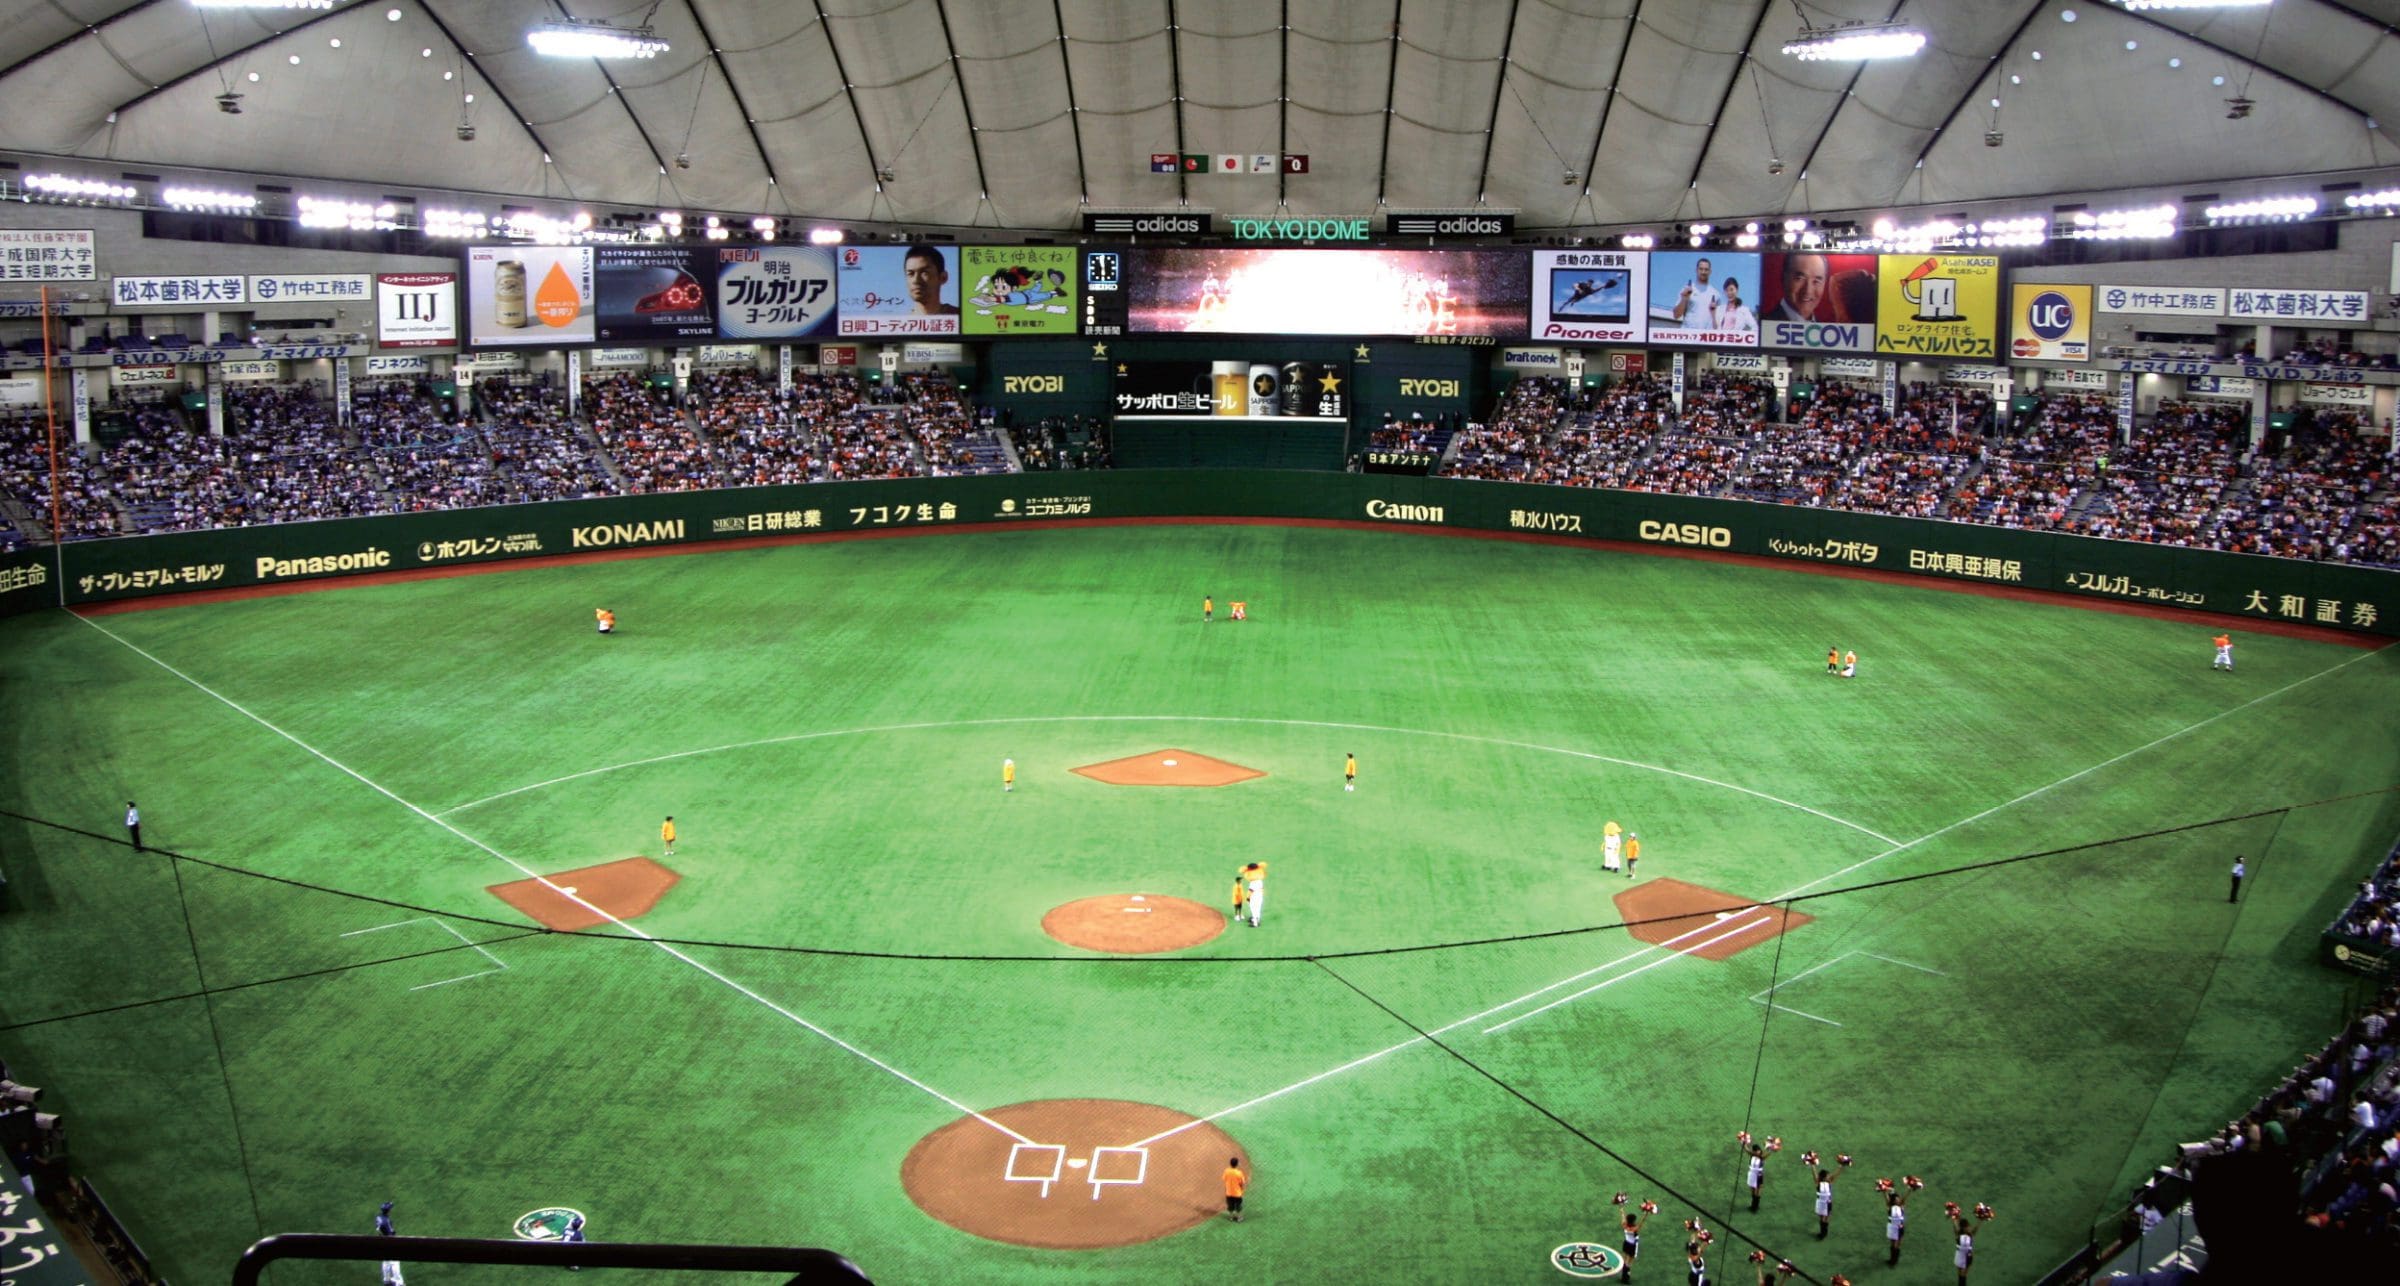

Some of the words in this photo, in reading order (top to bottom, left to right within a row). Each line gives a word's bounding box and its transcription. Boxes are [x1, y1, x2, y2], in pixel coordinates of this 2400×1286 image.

[1136, 217, 1199, 233] adidas
[1230, 220, 1304, 240] TOKYO
[1308, 220, 1370, 240] DOME
[1438, 218, 1502, 234] adidas
[720, 248, 760, 263] MEIJI
[1556, 254, 1627, 266] 感動の高画質
[764, 261, 791, 274] 明治
[118, 279, 241, 301] 松本歯科大学
[282, 280, 363, 296] 竹中工務店
[726, 275, 829, 306] ブルガリア
[395, 292, 439, 322] IIJ
[2131, 293, 2217, 310] 竹中工務店
[2233, 292, 2364, 317] 松本歯科大学
[746, 305, 810, 323] ヨーグルト
[842, 319, 956, 333] 日興コーディアル証券
[1544, 323, 1634, 341] Pioneer
[1776, 323, 1857, 348] SECOM
[1878, 335, 1993, 355] ヘーベルハウス
[113, 352, 171, 365] B.V.D.
[1779, 372, 1784, 381] 3
[2244, 365, 2305, 380] B.V.D.
[1003, 376, 1063, 393] RYOBI
[1399, 379, 1459, 398] RYOBI
[1116, 391, 1238, 410] サッポロ生ビール
[1368, 453, 1431, 466] 日本アンテナ
[849, 501, 958, 525] フコク生命
[1025, 503, 1092, 516] コニカミノルタ
[1365, 499, 1444, 523] Canon
[747, 509, 822, 532] 日研総業
[1509, 509, 1582, 533] 積水ハウス
[572, 519, 685, 548] KONAMI
[1639, 519, 1732, 548] CASIO
[437, 537, 501, 559] ホクレン
[256, 546, 391, 578] Panasonic
[1909, 549, 2023, 582] 日本興亜損保
[79, 562, 225, 594] ザ・プレミアム・モルツ
[2243, 589, 2378, 628] 大和証券
